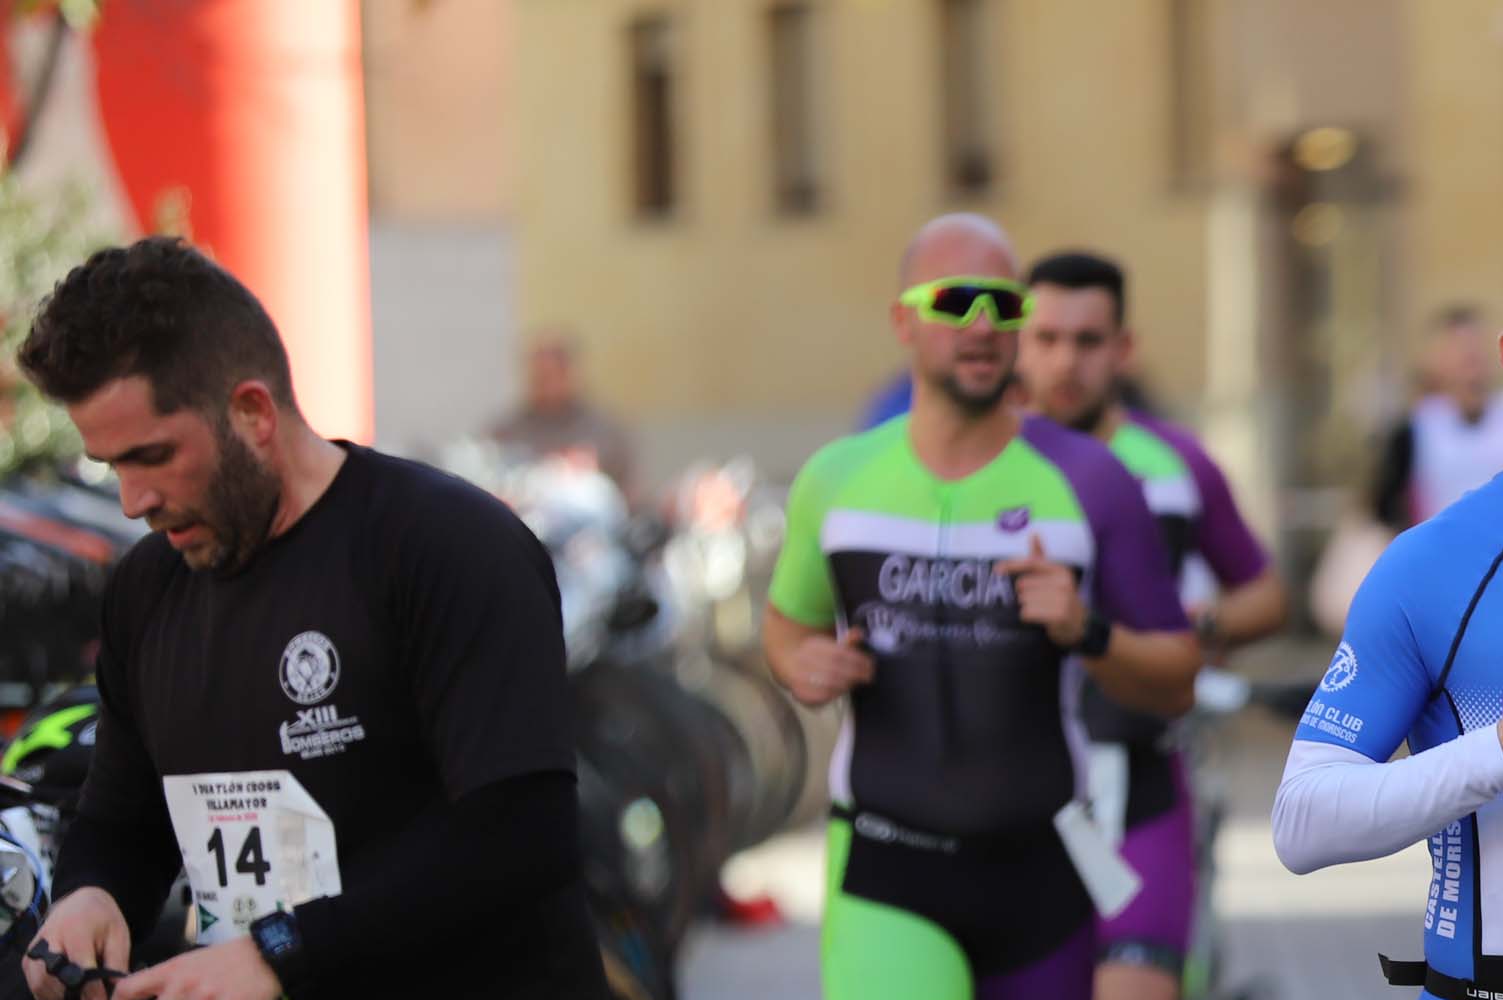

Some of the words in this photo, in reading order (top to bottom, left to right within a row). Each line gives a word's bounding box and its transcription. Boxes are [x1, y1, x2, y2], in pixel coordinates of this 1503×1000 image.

[296, 704, 338, 723] XIII
[1325, 706, 1364, 733] CLUB
[207, 826, 271, 888] 14
[1436, 906, 1458, 940] DE
